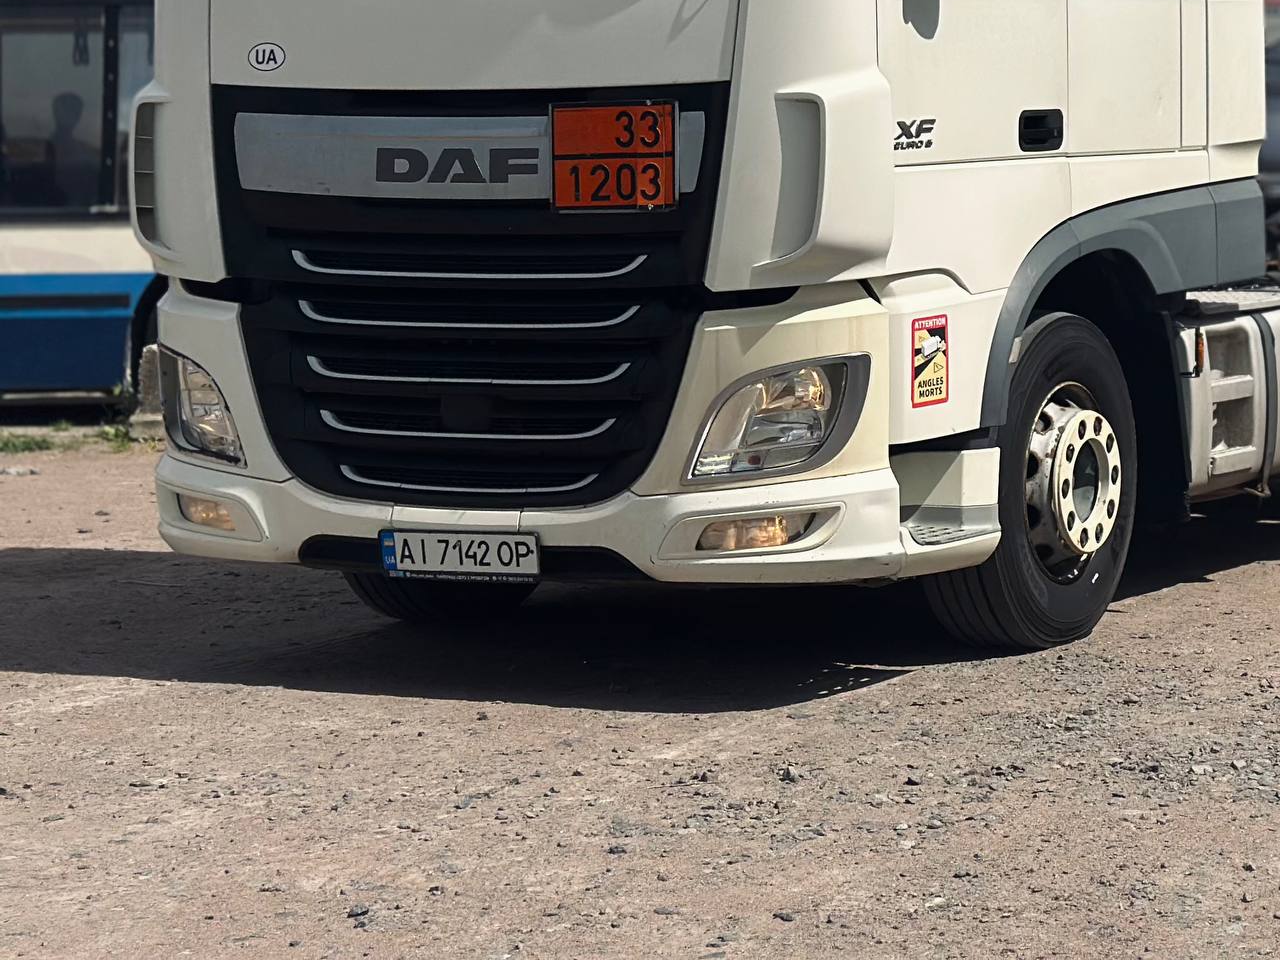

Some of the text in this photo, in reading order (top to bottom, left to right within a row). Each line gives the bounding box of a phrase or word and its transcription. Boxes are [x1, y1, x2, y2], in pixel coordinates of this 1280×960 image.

[254, 48, 278, 66] UA
[615, 110, 660, 148] 33
[894, 119, 936, 140] XF
[375, 148, 540, 184] DAF
[568, 162, 662, 203] 1203
[918, 377, 944, 389] ANGLES
[919, 387, 943, 399] MORTS
[384, 555, 396, 564] UA
[400, 538, 531, 567] AI 7142 OP
